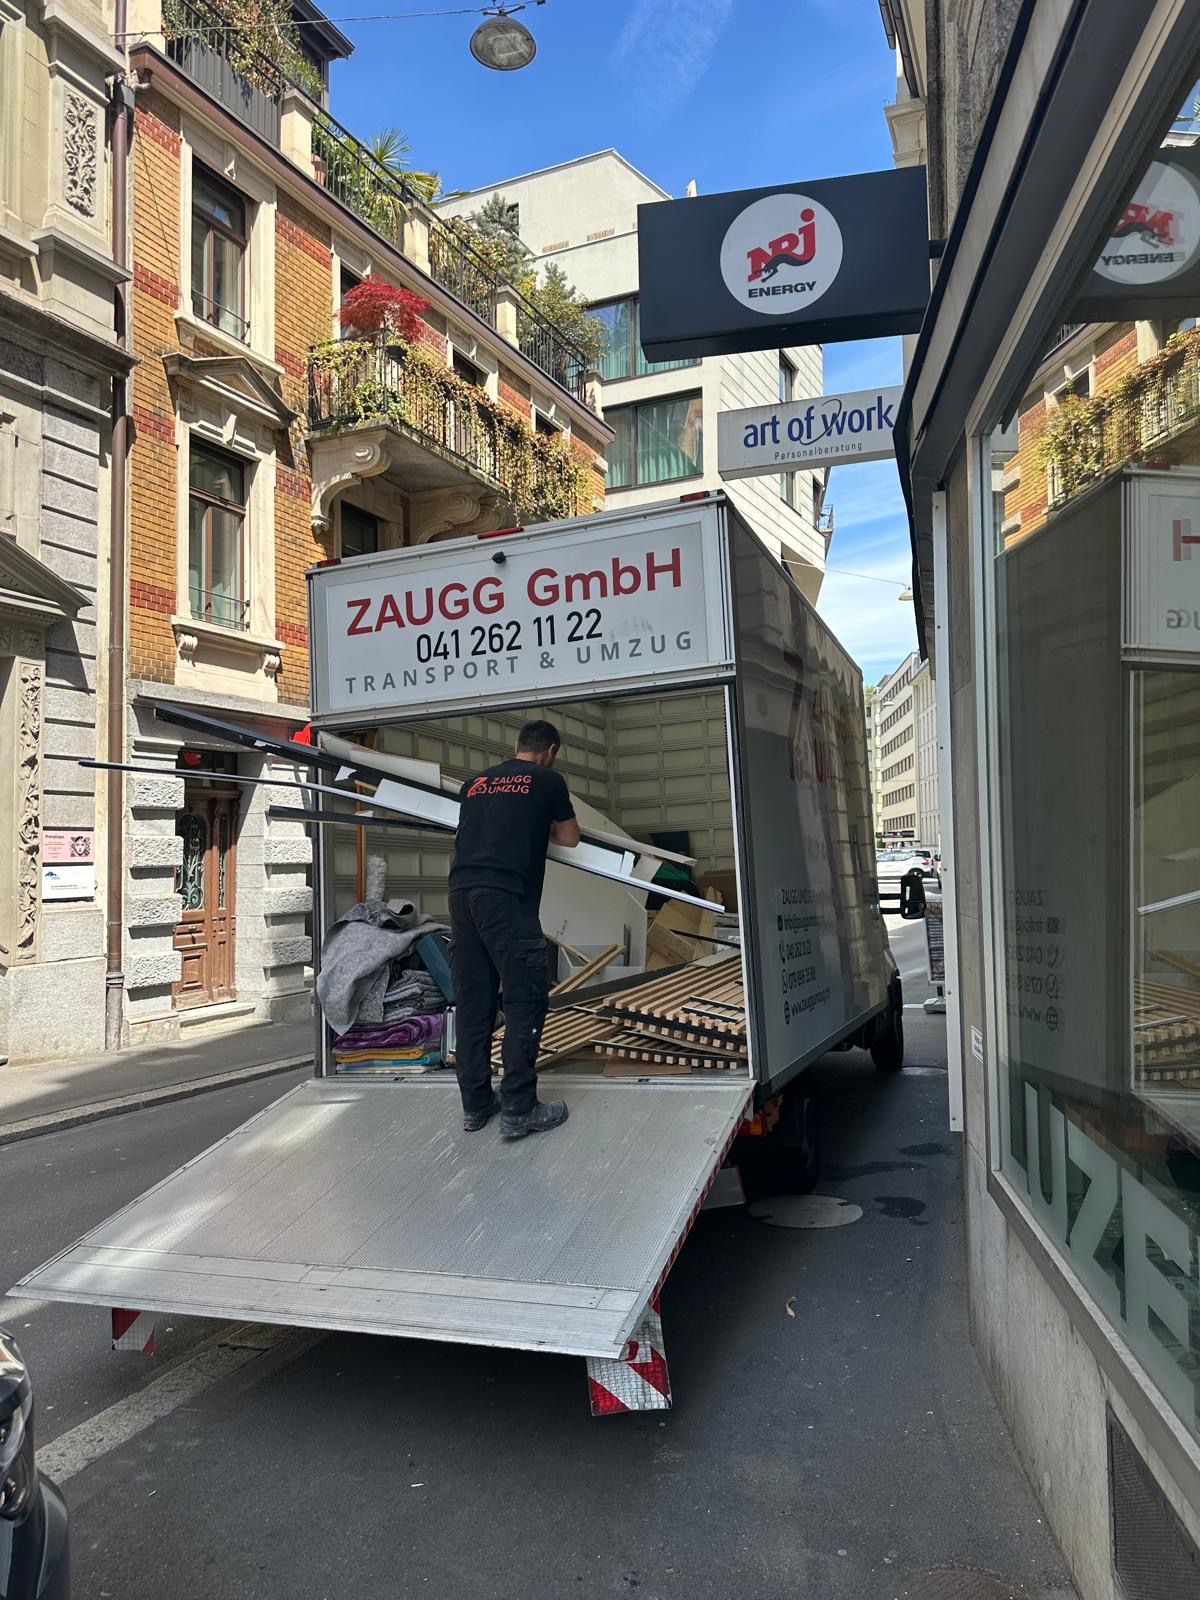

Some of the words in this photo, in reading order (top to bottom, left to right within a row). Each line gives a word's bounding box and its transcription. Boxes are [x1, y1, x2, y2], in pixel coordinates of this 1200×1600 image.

[748, 281, 817, 298] ENERGY
[743, 415, 780, 448] art
[787, 405, 815, 441] of
[821, 396, 895, 436] work
[775, 442, 863, 461] Personalberatung
[347, 576, 505, 636] ZAUGG
[527, 547, 682, 606] GmbH
[416, 629, 460, 663] 041
[471, 621, 522, 656] 262
[533, 615, 556, 647] 11
[566, 608, 603, 643] 22
[345, 656, 519, 694] TRANSPORT
[539, 651, 555, 669] &
[576, 631, 691, 664] UMZUG
[488, 784, 530, 794] UMZUG
[491, 775, 532, 785] ZAUGG
